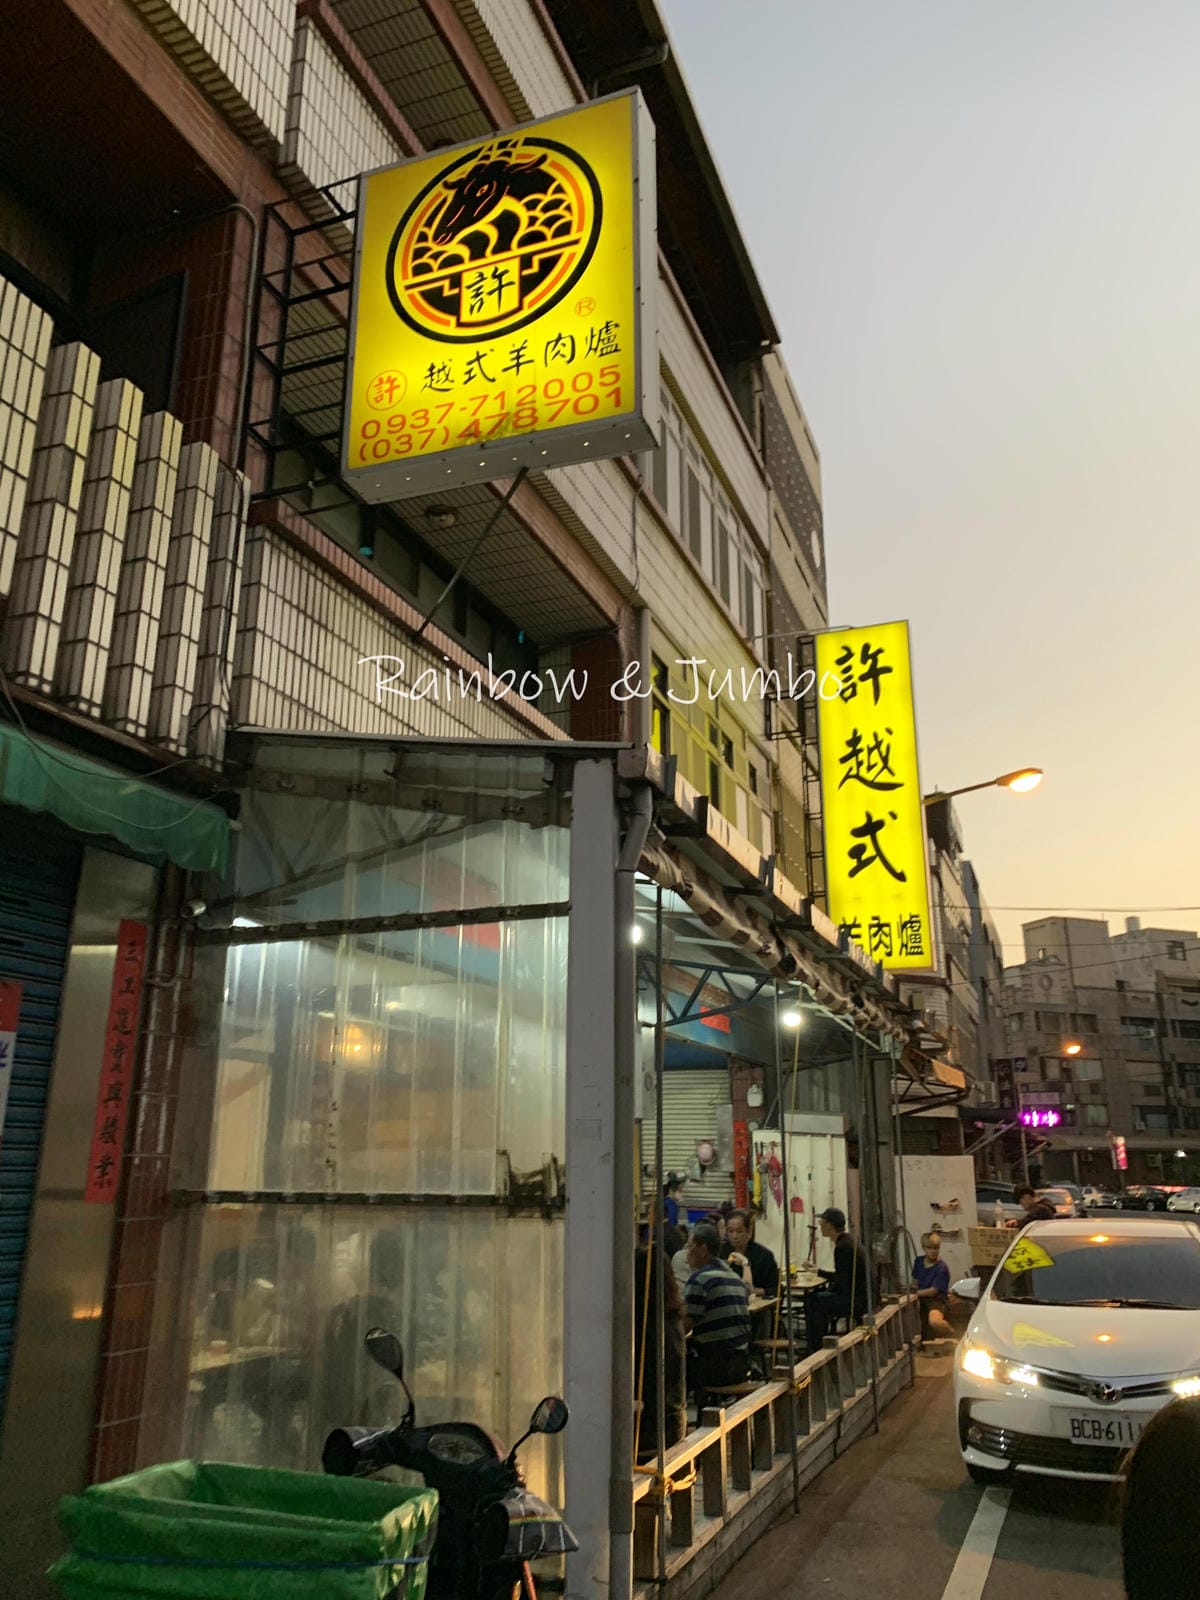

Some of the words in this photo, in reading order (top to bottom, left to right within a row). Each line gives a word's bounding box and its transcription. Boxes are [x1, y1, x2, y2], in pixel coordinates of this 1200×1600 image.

[466, 267, 515, 316] 許
[373, 374, 402, 405] 許
[421, 320, 622, 393] 越式羊肉爐
[361, 365, 622, 440] 0937-712005
[837, 643, 907, 882] 許越式
